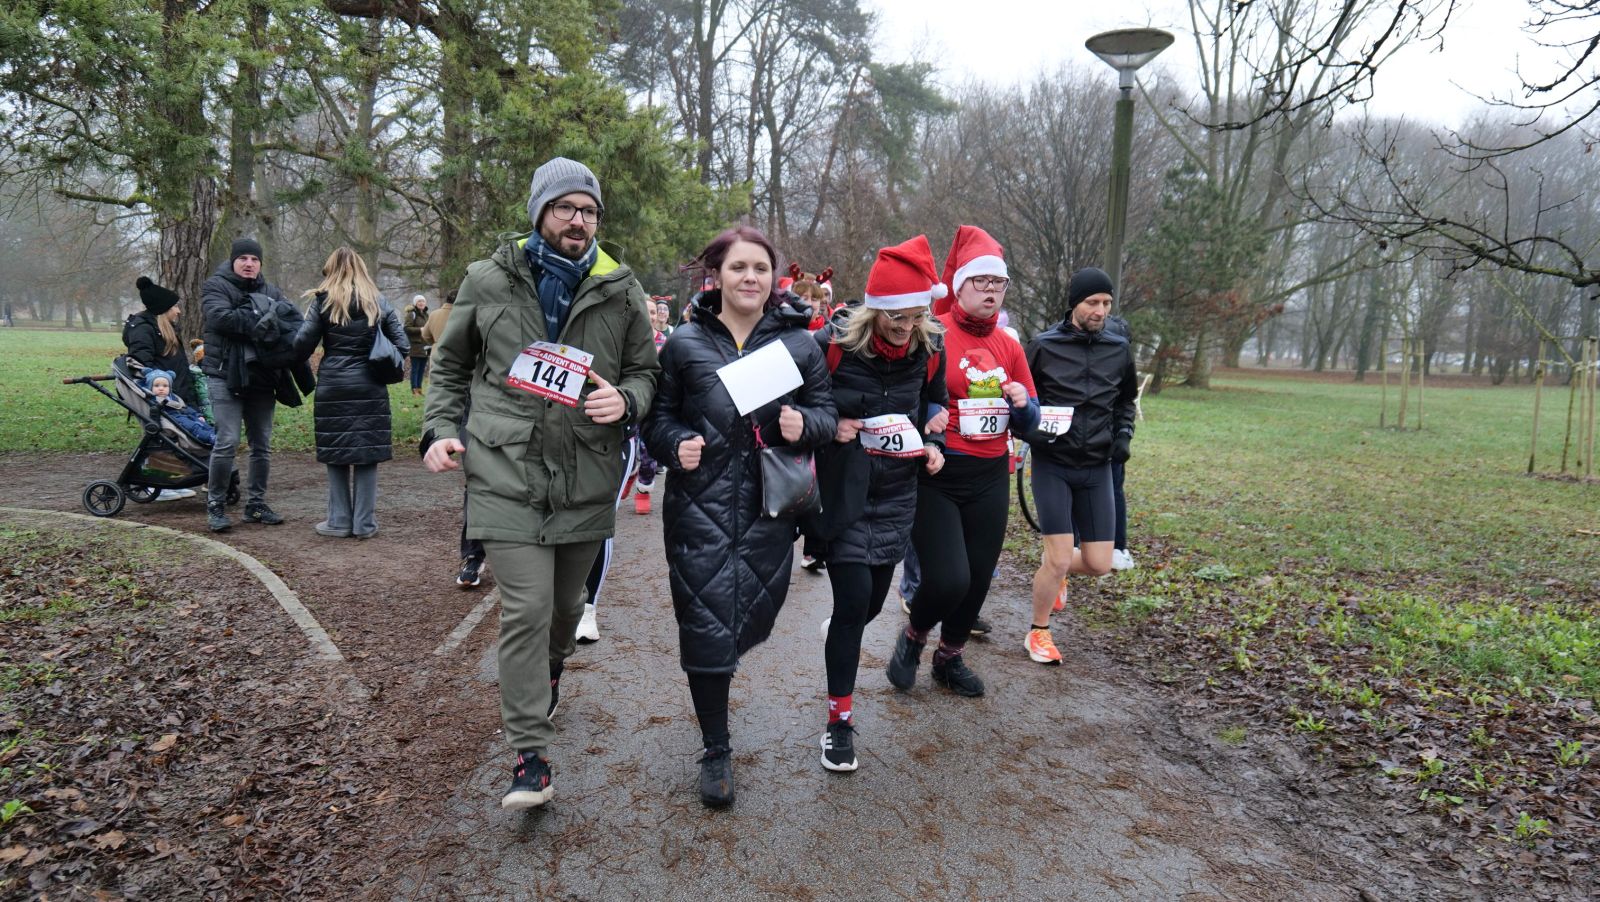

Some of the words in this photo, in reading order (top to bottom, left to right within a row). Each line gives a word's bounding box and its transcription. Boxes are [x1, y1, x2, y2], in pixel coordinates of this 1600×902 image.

[531, 360, 570, 393] 144
[979, 415, 998, 433] 28
[1041, 420, 1059, 434] 36
[879, 433, 904, 452] 29
